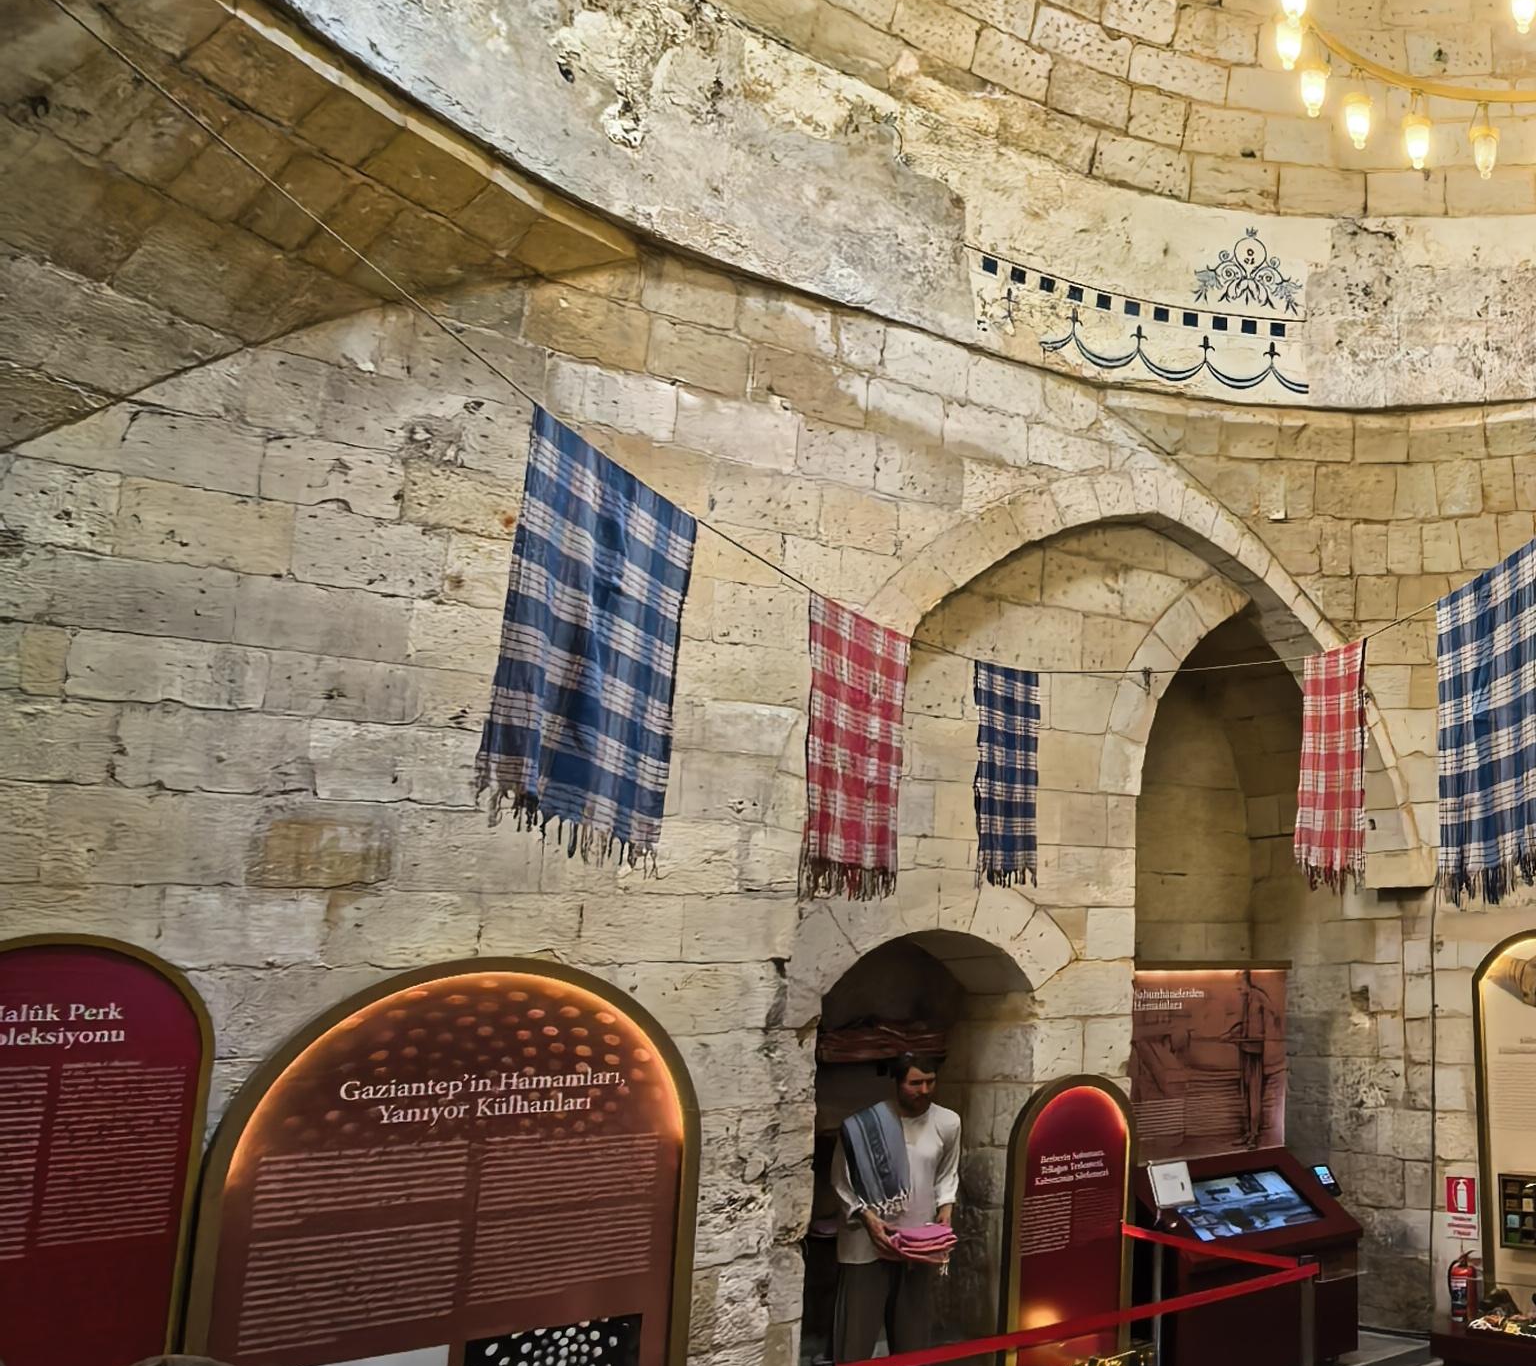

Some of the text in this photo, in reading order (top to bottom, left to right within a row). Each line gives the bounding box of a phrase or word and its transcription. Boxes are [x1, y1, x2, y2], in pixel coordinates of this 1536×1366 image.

[68, 1002, 125, 1021] Perk
[500, 1067, 626, 1091] Hamamları,
[378, 1092, 592, 1127] Yanıyor Külhanları
